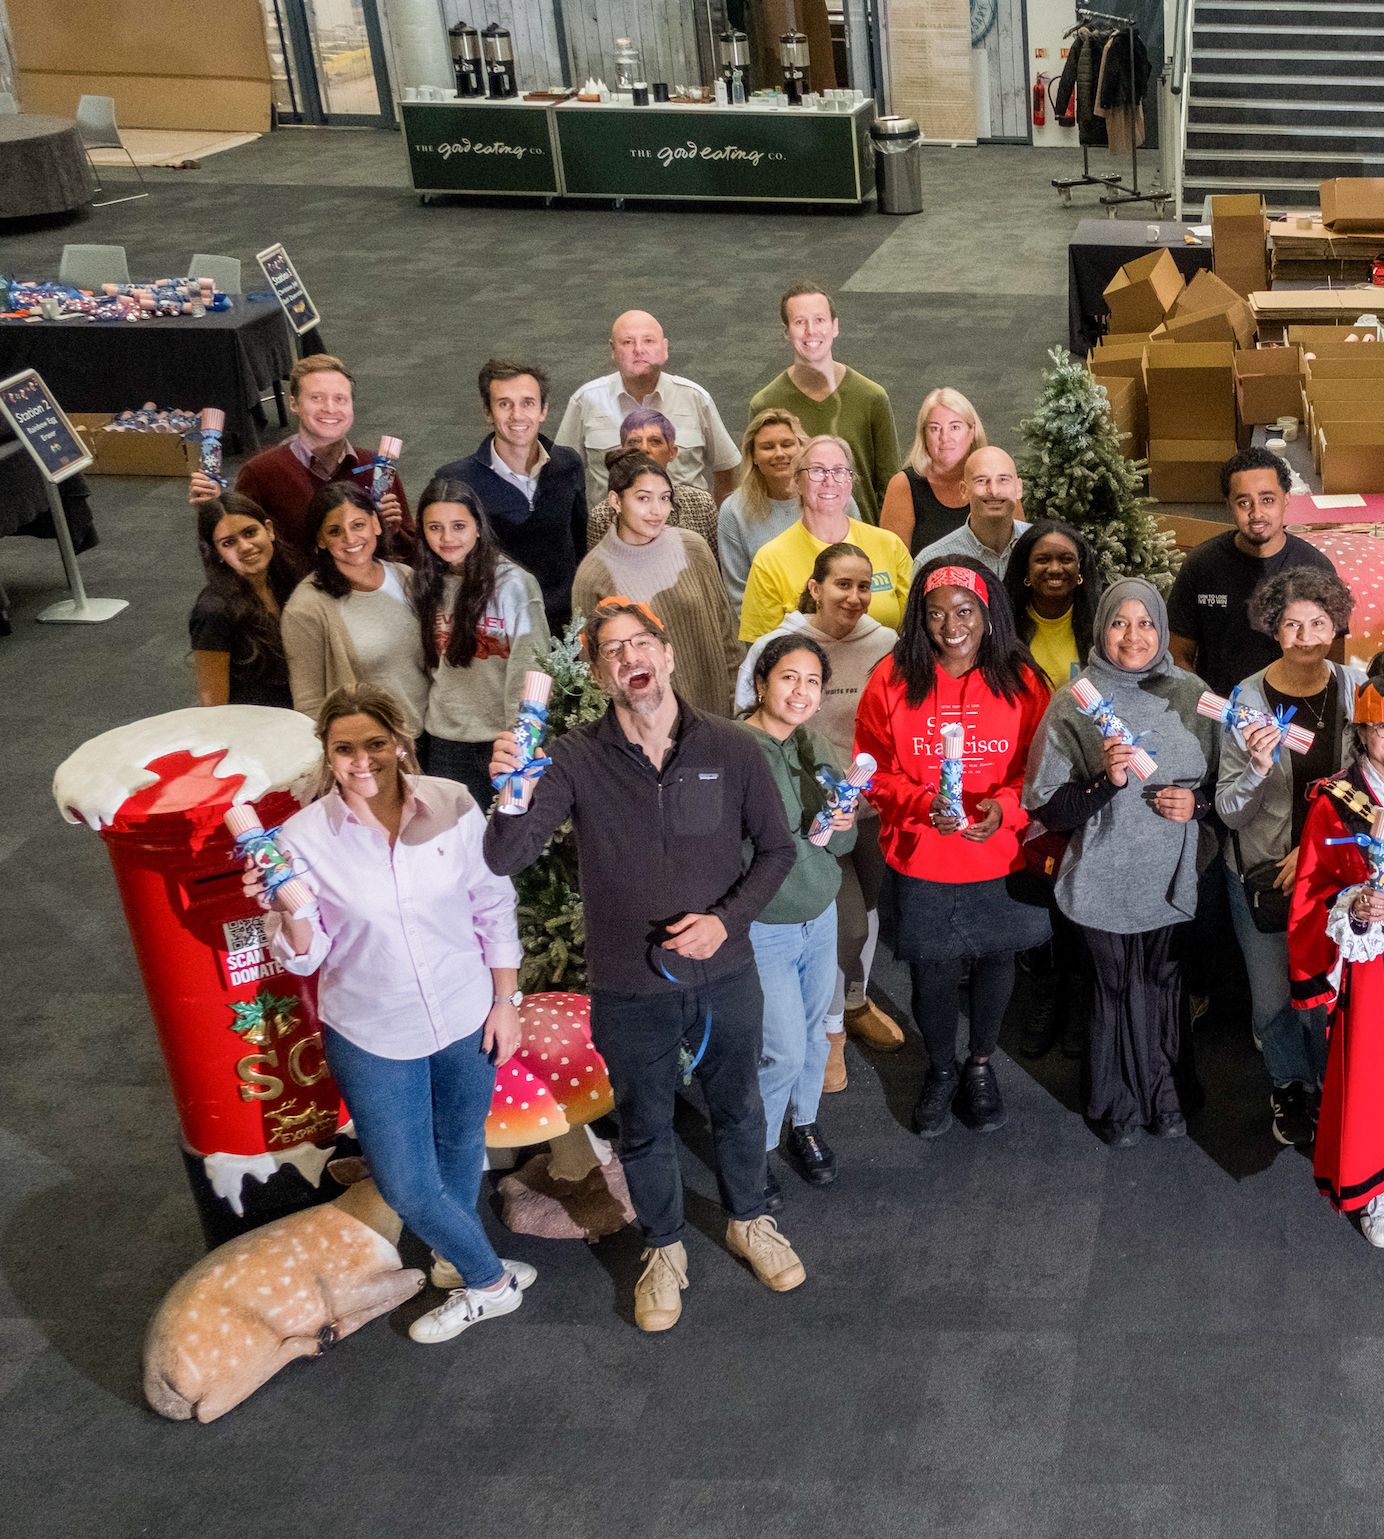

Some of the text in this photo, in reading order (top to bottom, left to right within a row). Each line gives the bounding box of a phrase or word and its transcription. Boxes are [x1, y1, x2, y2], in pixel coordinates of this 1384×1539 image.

[437, 138, 472, 160] good
[472, 142, 527, 160] eating
[630, 141, 787, 167] THE good eating CO.
[15, 400, 52, 424] Station 2
[226, 949, 266, 971] SCAN
